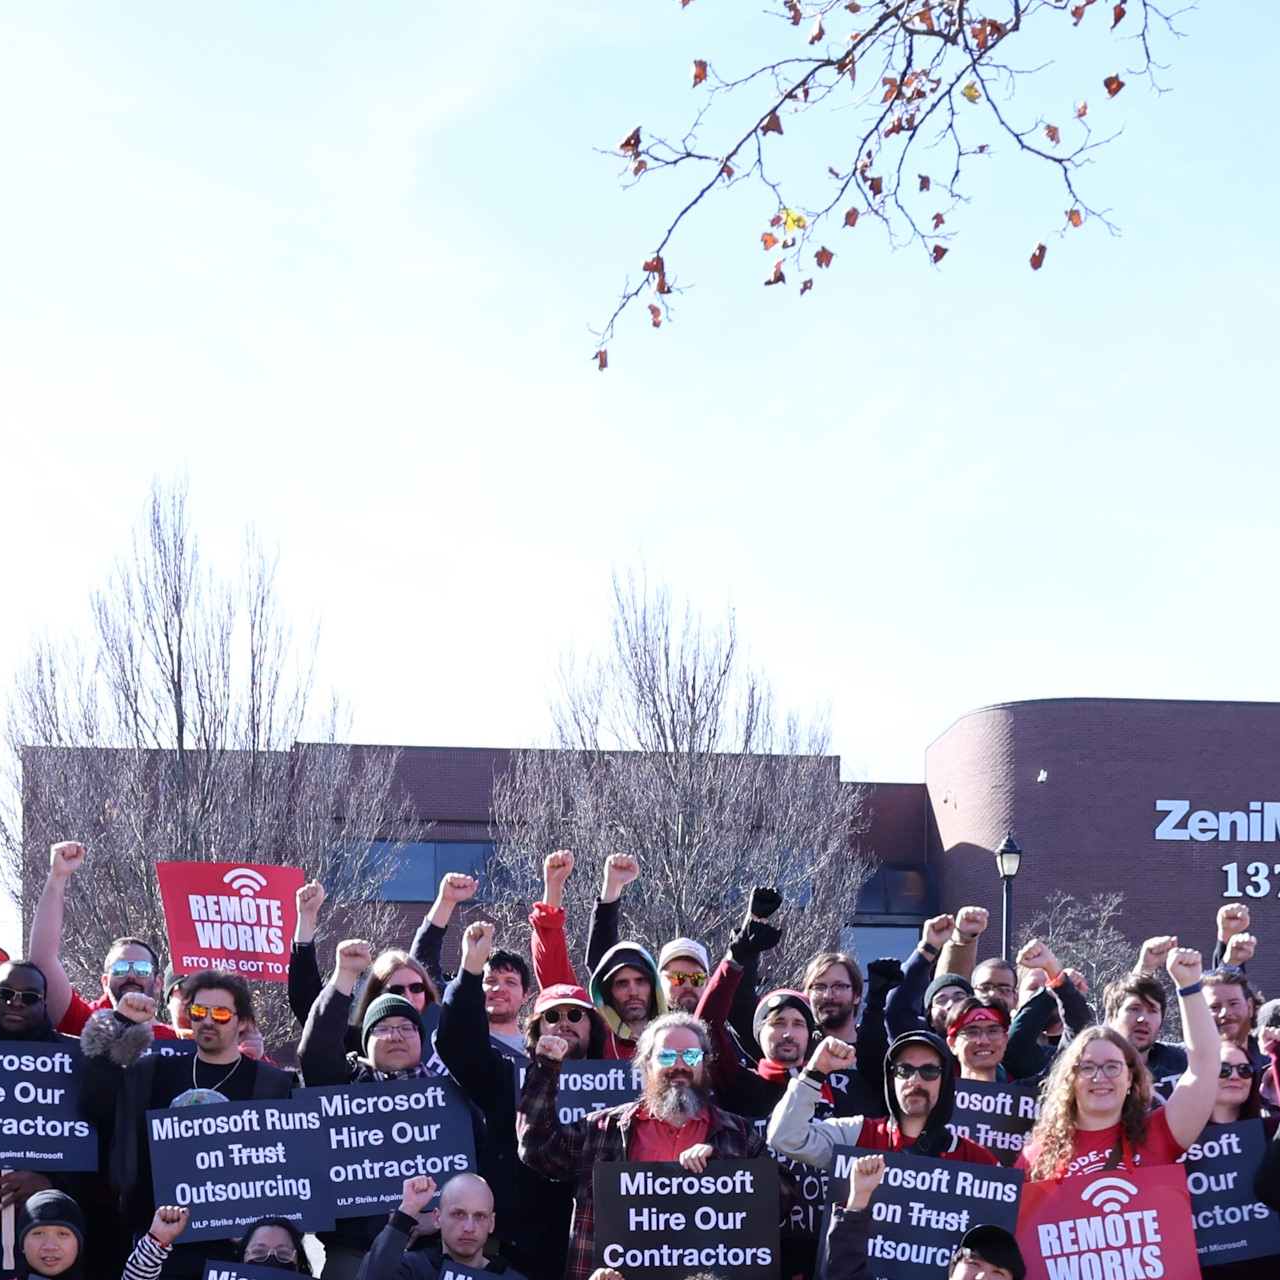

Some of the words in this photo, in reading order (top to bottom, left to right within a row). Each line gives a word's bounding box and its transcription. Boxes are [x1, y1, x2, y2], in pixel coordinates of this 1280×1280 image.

[188, 895, 283, 927] REMOTE
[195, 922, 284, 954] WORKS
[183, 956, 209, 968] RTO
[211, 958, 236, 970] HAS
[239, 960, 264, 972] GOT
[266, 962, 283, 974] TO
[14, 1082, 65, 1104] Our
[26, 1151, 63, 1159] Microsoft
[620, 1167, 754, 1195] Microsoft
[629, 1208, 686, 1231] Hire
[695, 1206, 746, 1230] Our
[603, 1244, 772, 1268] Contractors
